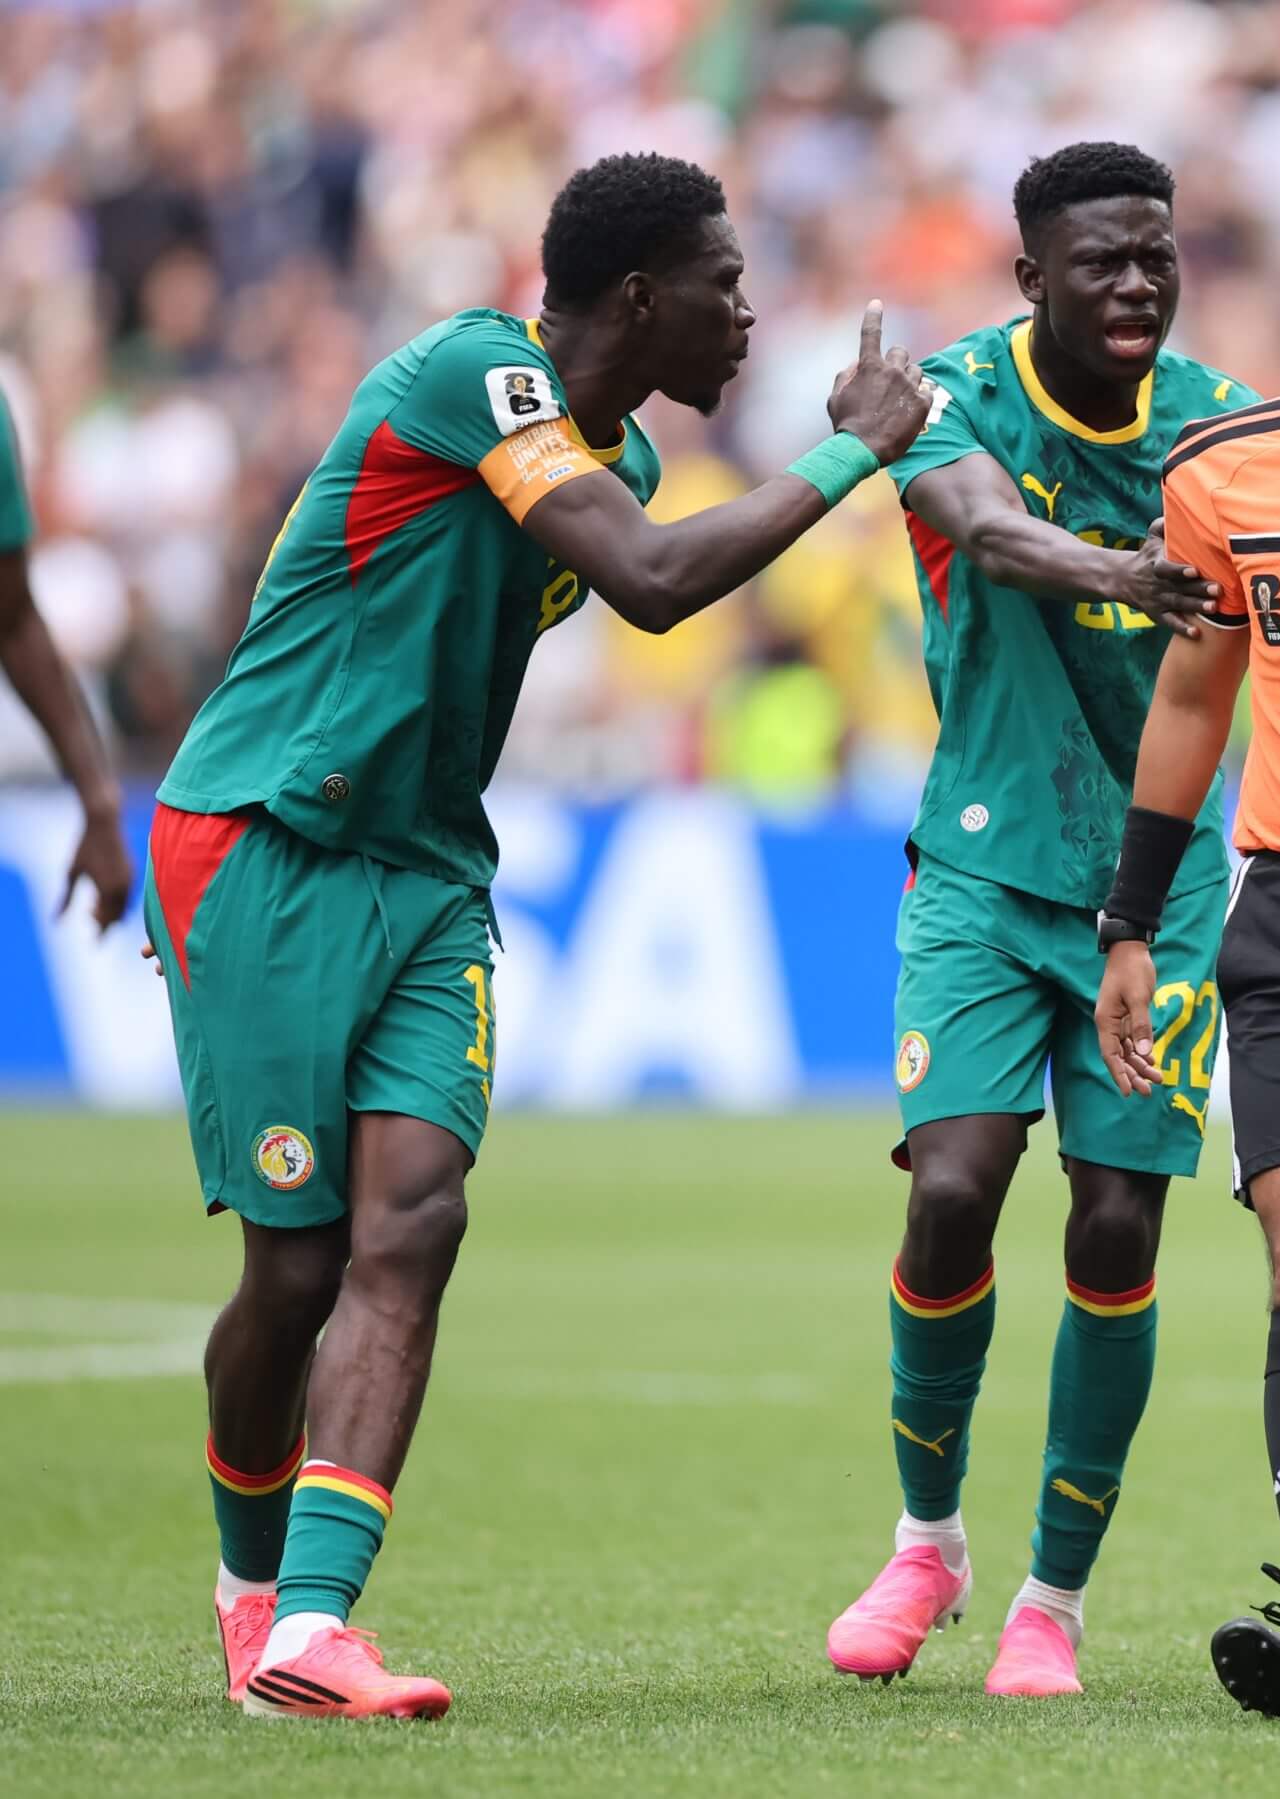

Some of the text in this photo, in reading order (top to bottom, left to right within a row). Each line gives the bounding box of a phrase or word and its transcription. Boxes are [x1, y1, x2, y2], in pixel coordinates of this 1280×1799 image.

[507, 421, 561, 457] FOOTBALL
[511, 433, 570, 471] UNITES
[547, 466, 572, 481] FIFA
[1152, 980, 1217, 1089] 22
